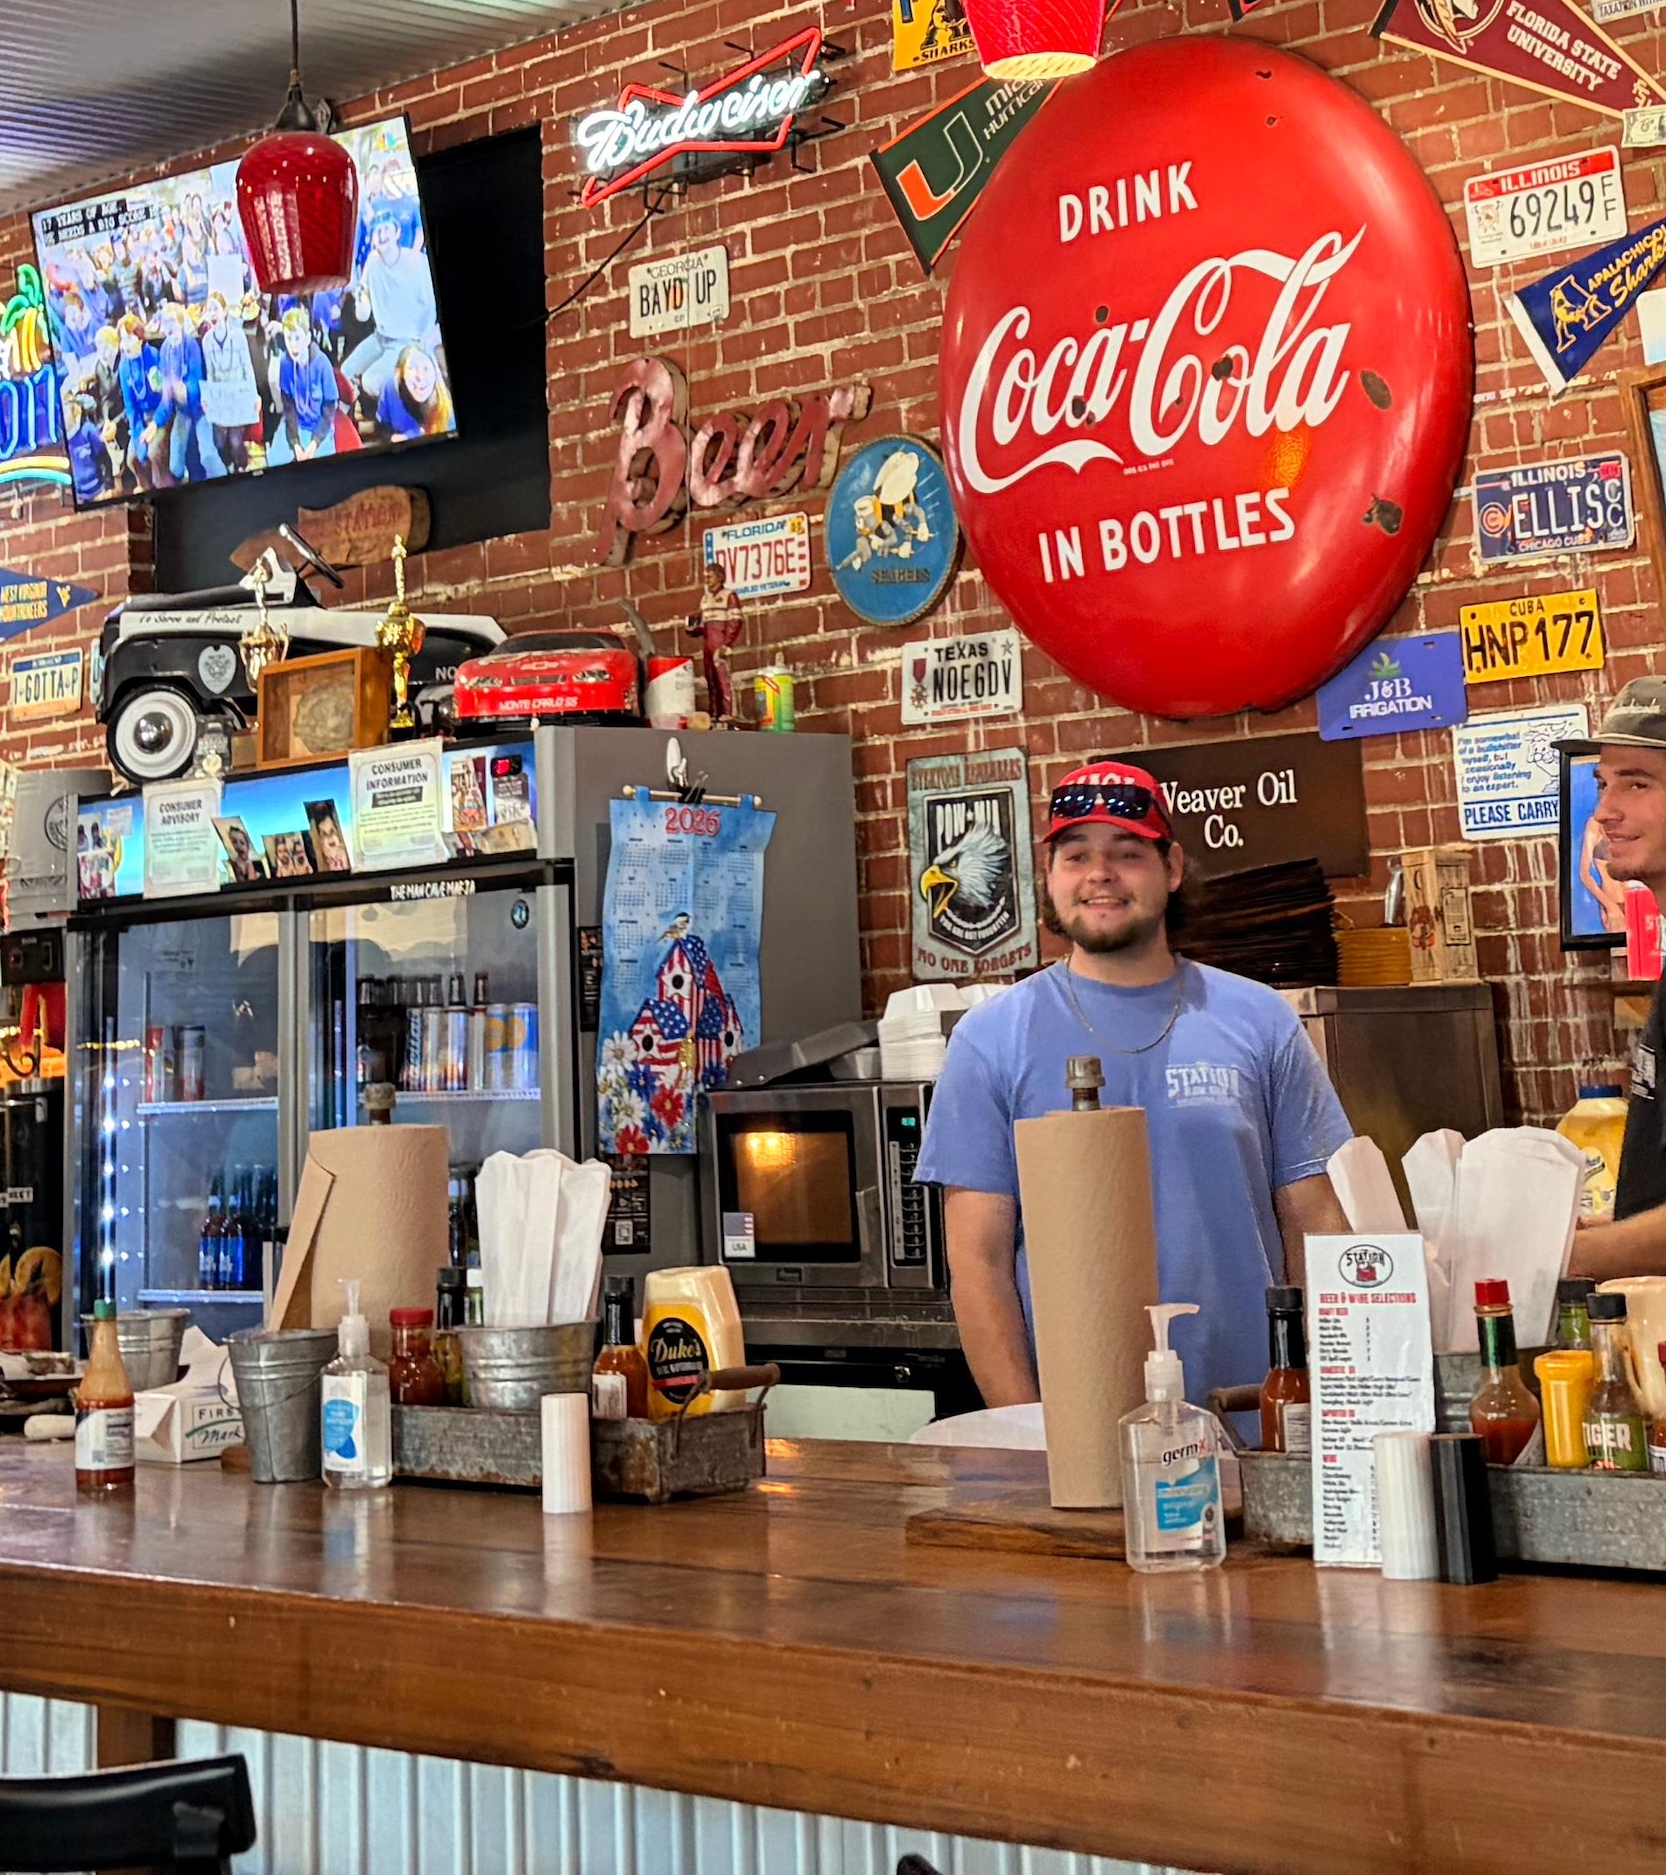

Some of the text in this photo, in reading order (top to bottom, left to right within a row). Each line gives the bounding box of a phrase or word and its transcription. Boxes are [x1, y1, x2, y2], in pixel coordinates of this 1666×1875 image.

[1506, 26, 1605, 93] UNIVERSITY
[1569, 34, 1623, 82] STATE
[578, 68, 823, 172] Budweiser
[1499, 159, 1582, 193] ILLINOIS
[1058, 160, 1199, 244] DRINK
[1509, 180, 1596, 240] 69249
[649, 255, 706, 281] GEORGIA
[695, 268, 717, 305] UP
[959, 222, 1368, 495] Coca-Cola
[599, 355, 871, 567] Beer
[1510, 461, 1587, 487] ILLINOIS
[1513, 477, 1606, 541] ELLIS
[725, 519, 790, 542] FLORIDA
[1037, 486, 1296, 585] IN BOTTLES
[1518, 532, 1591, 553] CHICAGO CUBS
[1510, 599, 1545, 618] CUBA
[935, 641, 990, 665] TEXAS
[1463, 611, 1596, 675] HNP 177
[499, 700, 529, 711] MONTE
[1363, 676, 1414, 703] J&B
[1349, 695, 1434, 719] IRRIGATION
[366, 772, 429, 793] INFORMATION
[371, 757, 422, 776] CONSUMER
[1257, 768, 1298, 807] Oil
[159, 799, 203, 815] CONSUMER
[161, 813, 201, 827] ADVISORY
[666, 805, 722, 839] 2026
[1464, 799, 1559, 826] PLEASE CARRY
[1204, 815, 1245, 849] Co.
[941, 941, 1033, 975] ONE FORGETS
[649, 1334, 703, 1367] Duke's
